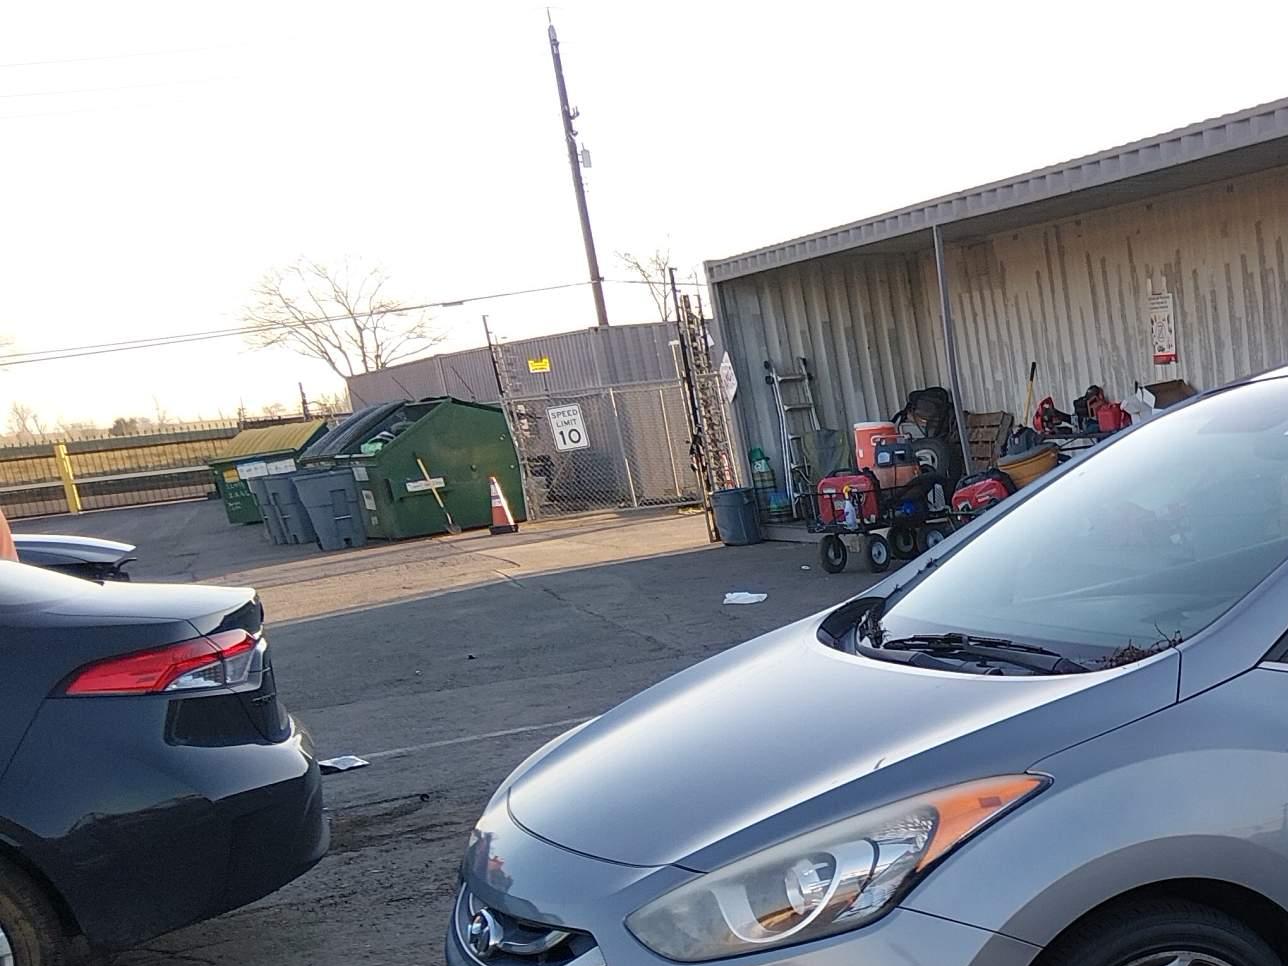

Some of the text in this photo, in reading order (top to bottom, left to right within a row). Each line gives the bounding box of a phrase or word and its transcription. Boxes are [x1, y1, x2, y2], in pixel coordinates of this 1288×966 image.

[551, 409, 578, 419] SPEED
[556, 419, 577, 428] LIMIT
[559, 428, 582, 445] 10
